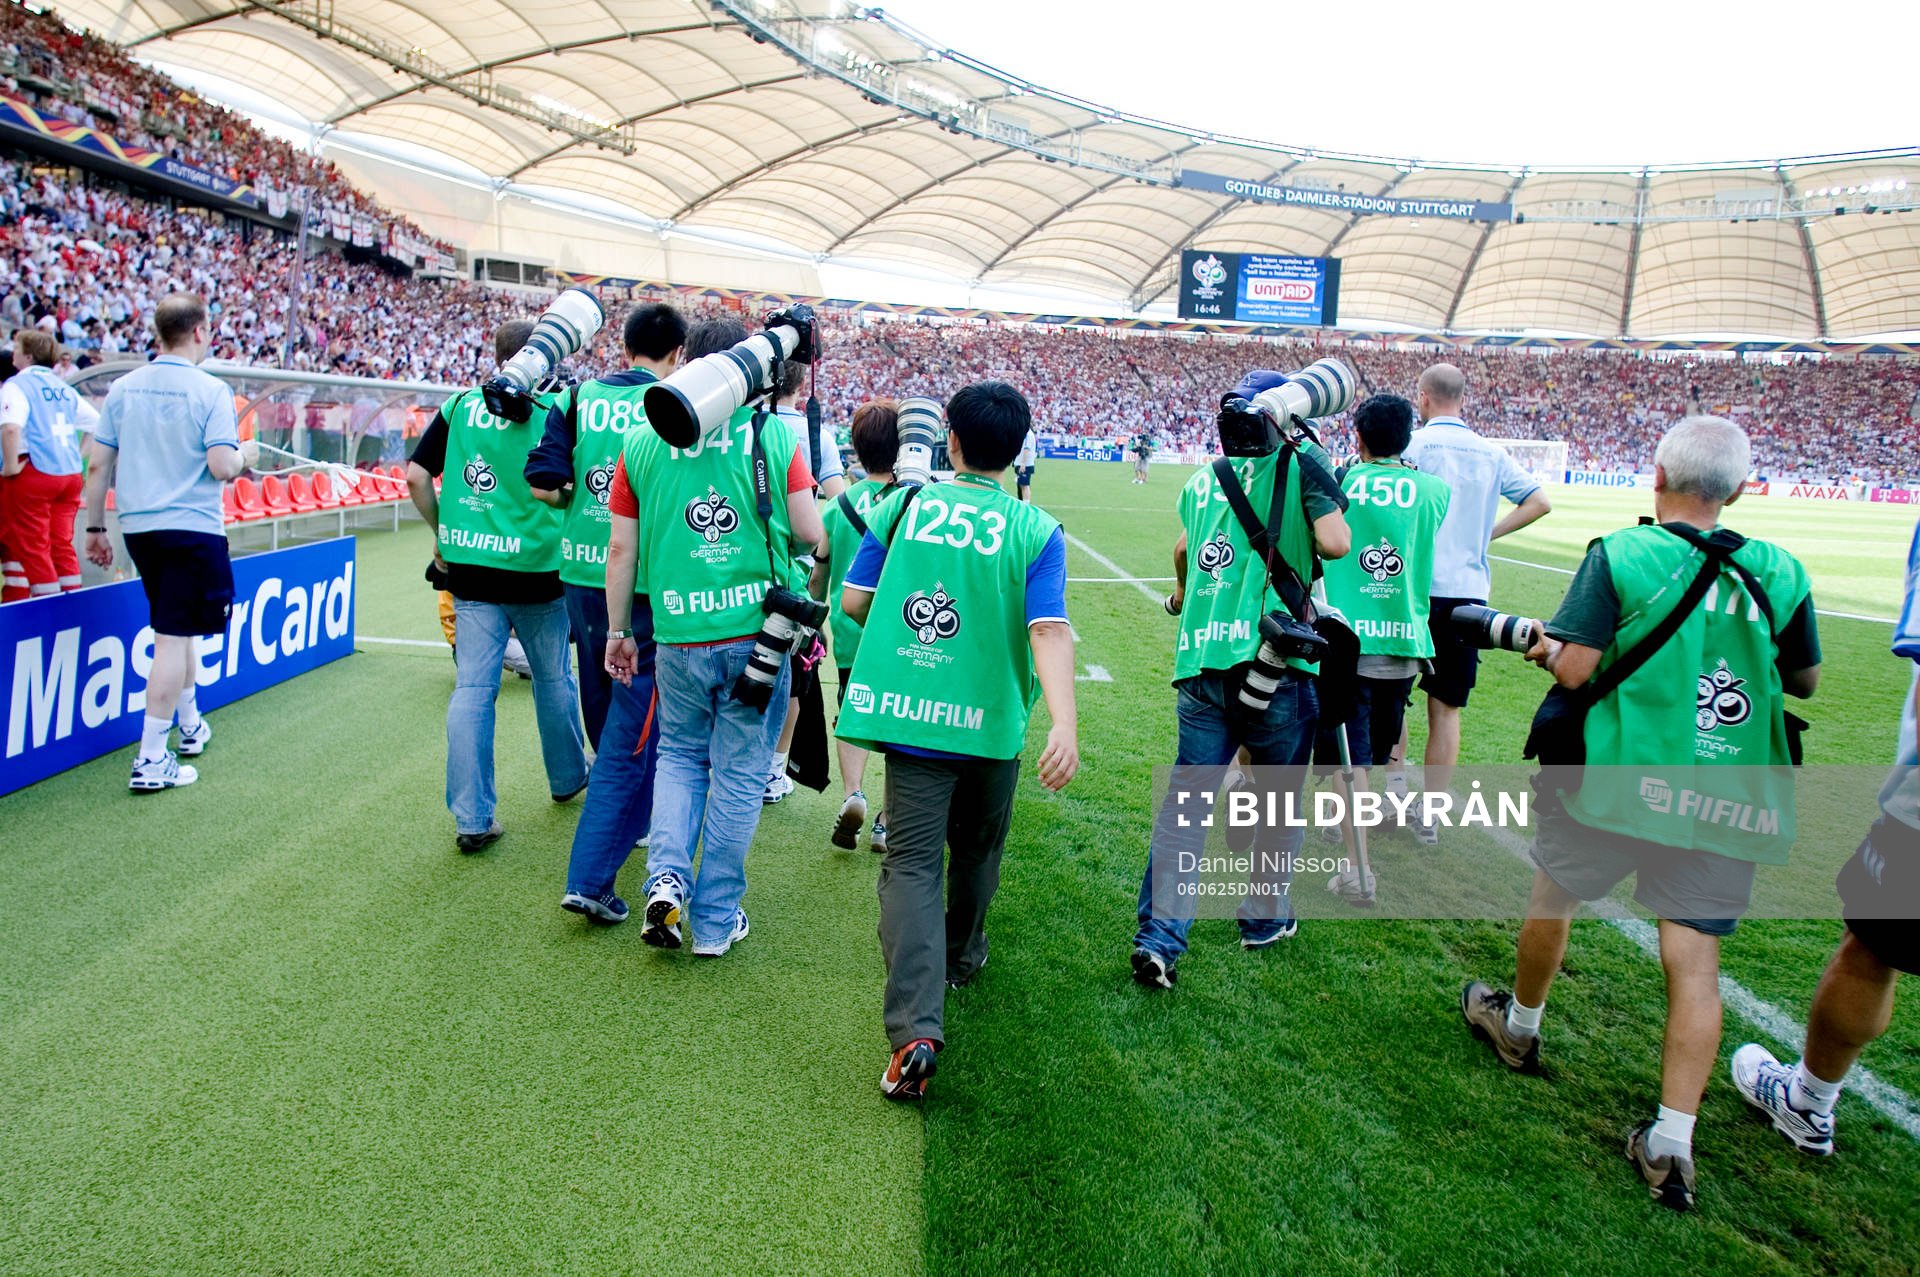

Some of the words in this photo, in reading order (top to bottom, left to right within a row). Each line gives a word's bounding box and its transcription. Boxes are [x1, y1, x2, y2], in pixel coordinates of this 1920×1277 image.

[166, 160, 212, 186] STUTTGART
[1400, 201, 1475, 217] STUTTGART
[1254, 284, 1313, 300] UNITAID
[1195, 304, 1220, 314] 16:46
[42, 387, 71, 402] DOC
[1077, 449, 1112, 461] EnBW
[756, 459, 767, 494] Canon
[1574, 472, 1636, 487] PHILIPS
[1346, 475, 1416, 508] 450
[1790, 485, 1849, 500] AVAYA
[904, 497, 1006, 556] 1253
[451, 529, 520, 554] FUJIFILM
[690, 546, 742, 558] GERMANY
[1354, 619, 1418, 640] FUJIFIL
[6, 560, 354, 758] MaserCard
[896, 647, 955, 664] GERMANY
[912, 659, 936, 669] 2006
[880, 691, 985, 730] FUJIFILM
